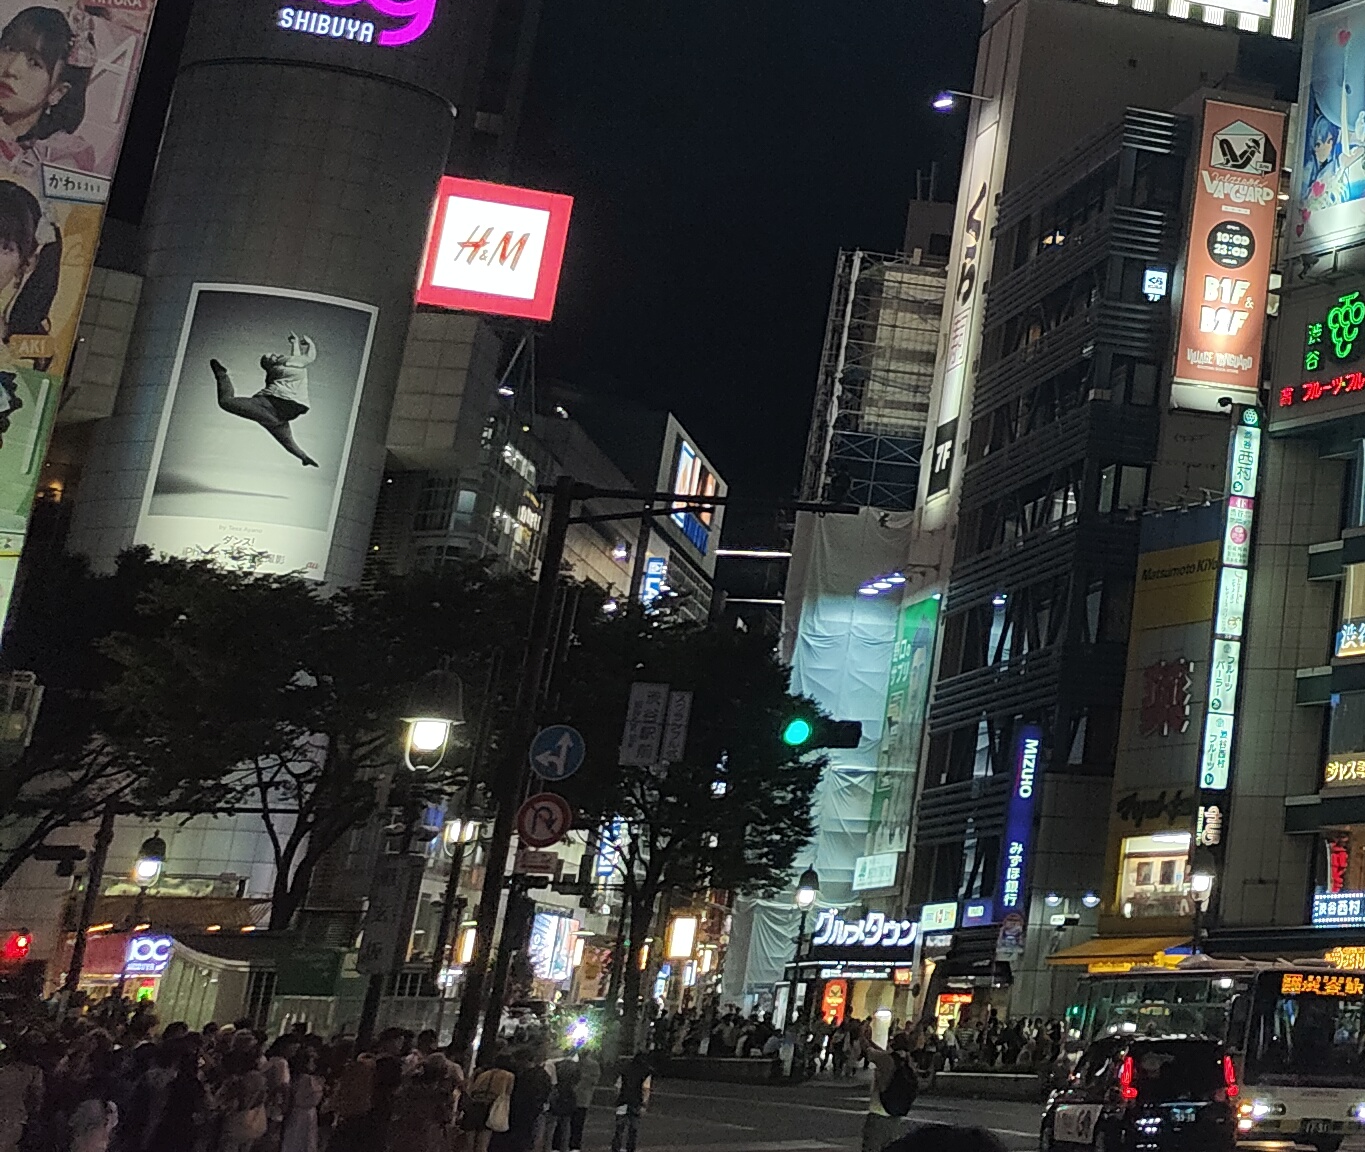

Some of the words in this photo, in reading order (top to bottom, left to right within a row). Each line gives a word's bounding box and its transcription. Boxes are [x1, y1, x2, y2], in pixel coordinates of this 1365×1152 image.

[278, 7, 376, 44] SHIBUYA
[47, 172, 104, 199] かわいい
[1201, 169, 1275, 206] VANGUARD
[453, 224, 532, 272] H&M
[1204, 275, 1252, 305] B1F
[1199, 304, 1250, 336] B2F
[1304, 323, 1323, 371] 渋谷
[222, 535, 256, 546] ダンス!
[1141, 561, 1196, 584] Matsumoto
[1018, 738, 1040, 799] MIZUHO
[1003, 842, 1024, 907] みずほ銀行
[813, 908, 921, 947] グルメタウン
